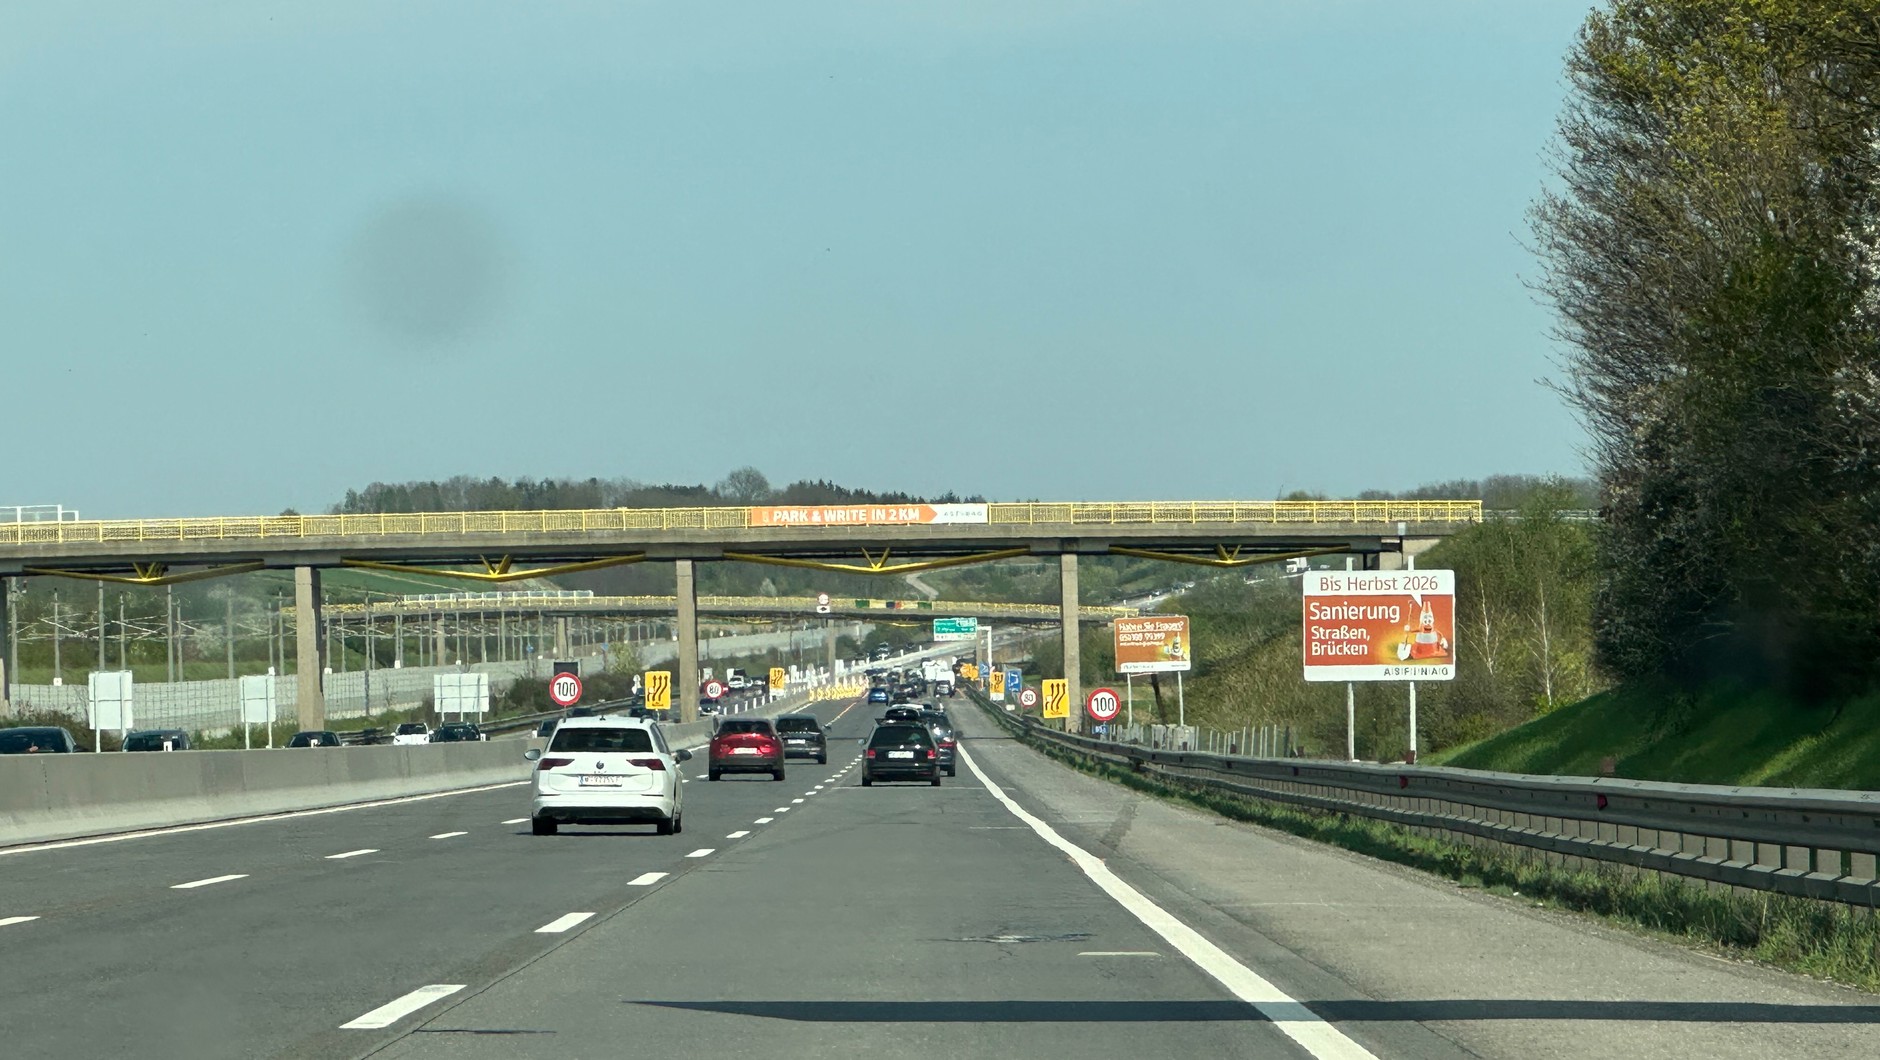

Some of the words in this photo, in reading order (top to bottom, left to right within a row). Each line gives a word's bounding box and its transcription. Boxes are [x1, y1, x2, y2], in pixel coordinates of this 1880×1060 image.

[773, 510, 808, 522] PARK
[811, 510, 821, 522] &
[824, 509, 866, 522] WRITE
[872, 508, 886, 521] IN
[889, 508, 897, 520] 2
[899, 507, 920, 520] KM
[1320, 576, 1341, 591] Bis
[1347, 576, 1398, 591] Herbst
[1402, 575, 1438, 591] 2026
[1309, 600, 1400, 623] Sanierung
[1311, 625, 1370, 641] Straßen,
[1311, 641, 1368, 656] Brücken
[556, 682, 576, 697] 100
[709, 685, 719, 695] 80
[1094, 697, 1115, 712] 100
